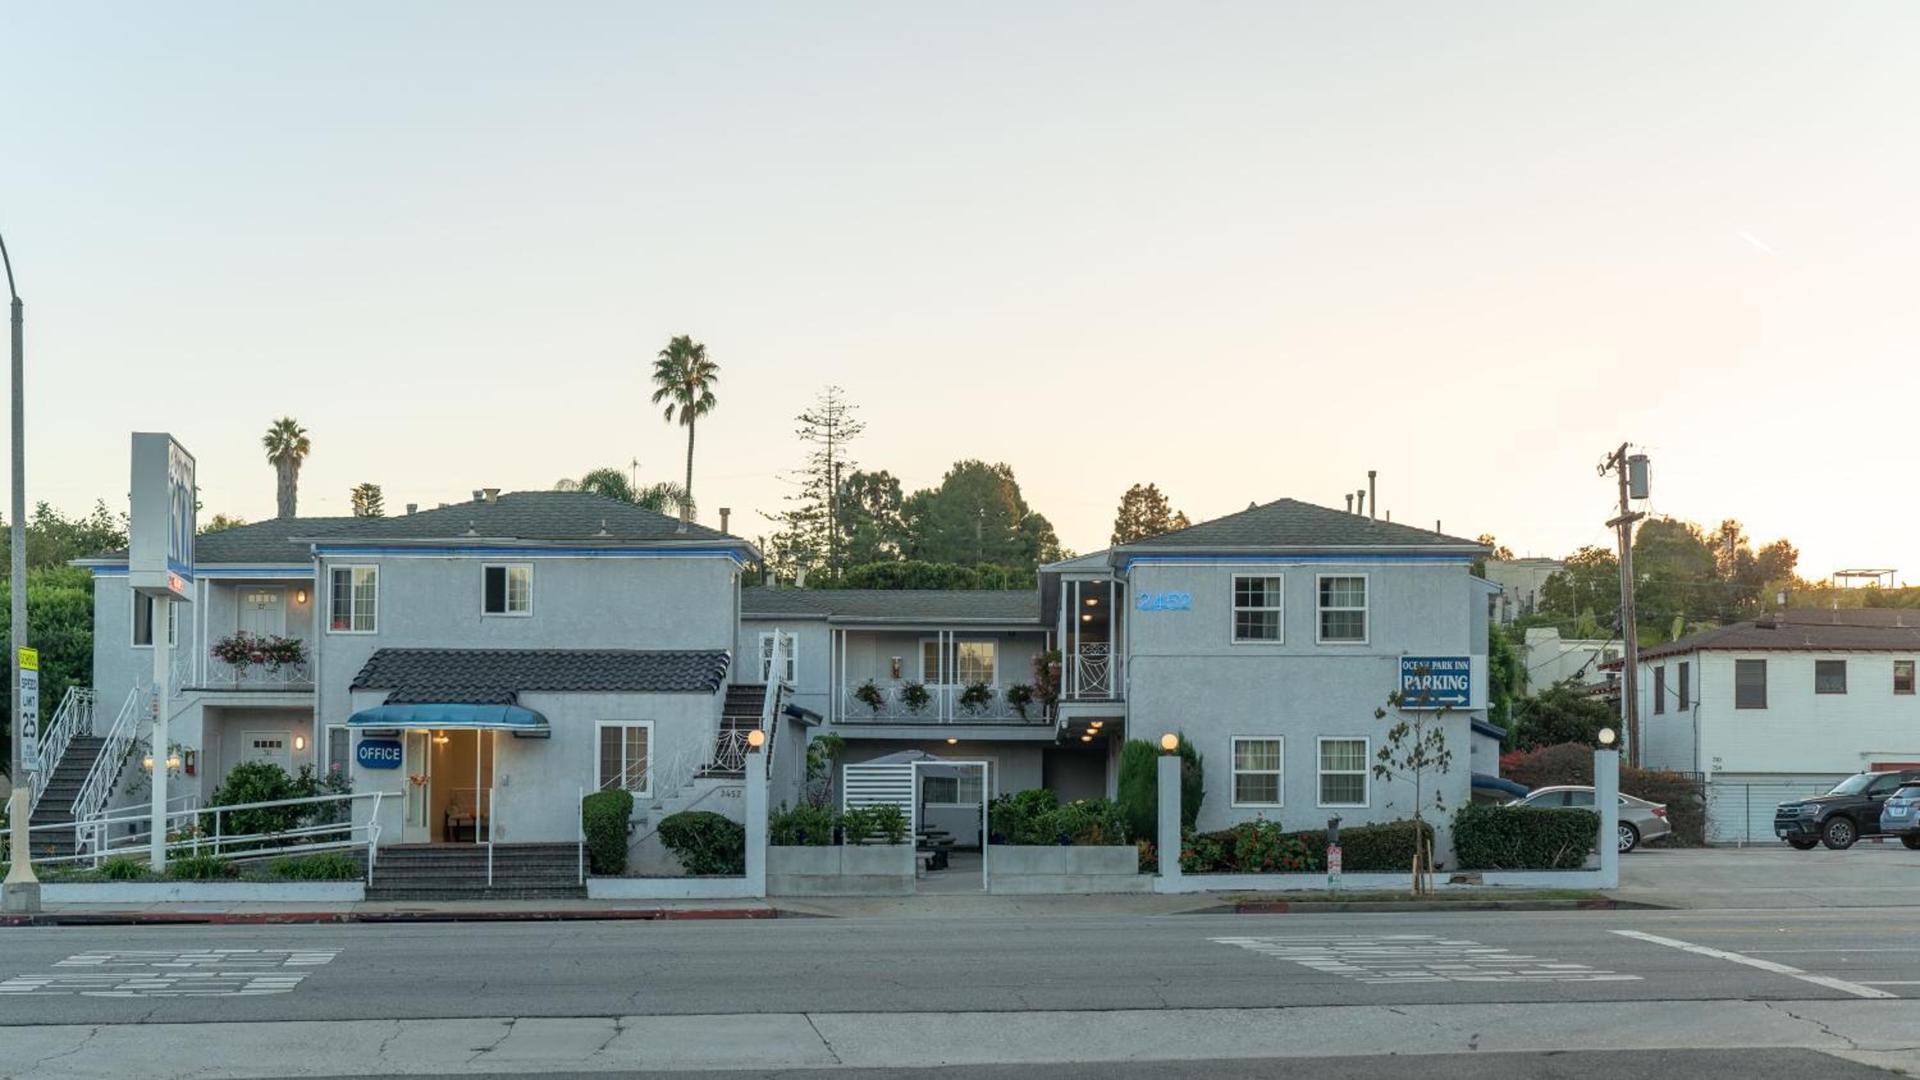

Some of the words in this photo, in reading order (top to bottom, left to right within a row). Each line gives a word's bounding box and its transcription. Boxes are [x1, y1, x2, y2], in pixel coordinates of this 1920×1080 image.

[1136, 592, 1191, 611] 2452
[1431, 661, 1452, 670] PARK
[1454, 661, 1469, 670] INN
[21, 677, 37, 690] SPEED
[1403, 675, 1468, 690] PARKING
[22, 695, 36, 707] LIMIT
[22, 712, 37, 738] 25
[359, 746, 400, 760] OFFICE
